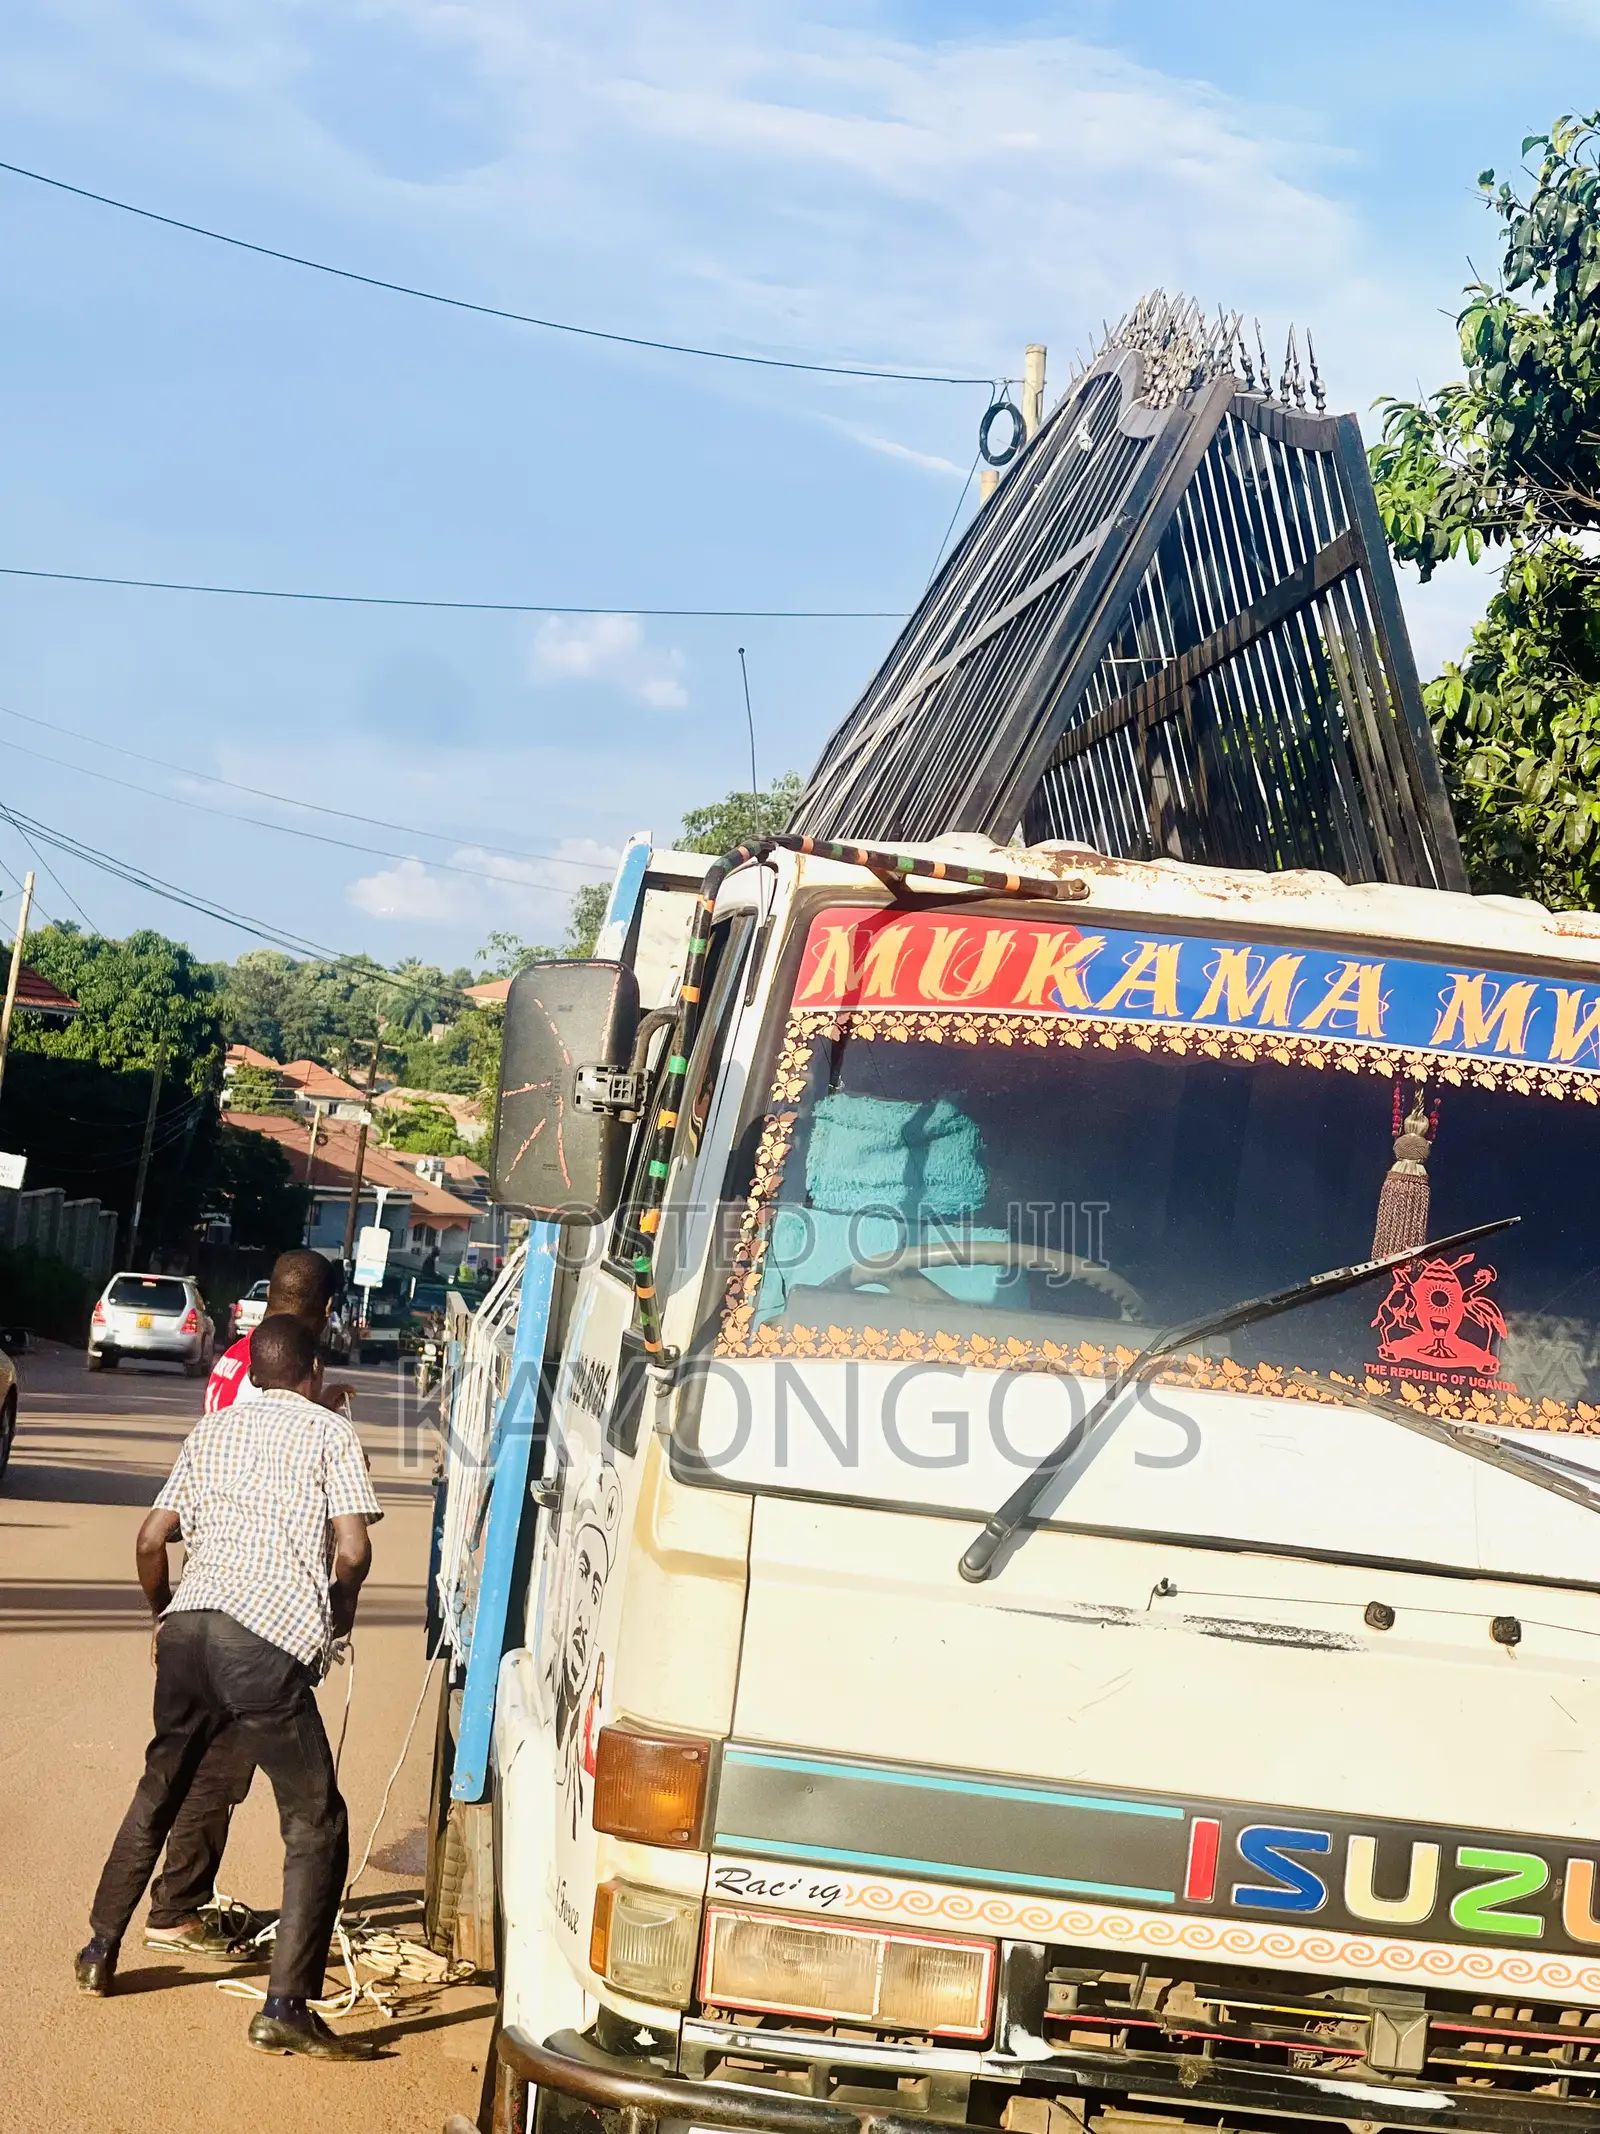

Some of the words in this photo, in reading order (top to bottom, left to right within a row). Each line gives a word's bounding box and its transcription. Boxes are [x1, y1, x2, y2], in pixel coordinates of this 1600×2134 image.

[799, 925, 1391, 1037] MUKAMA
[1363, 1362, 1387, 1376] THE
[1390, 1367, 1448, 1384] REPUBLIC
[1450, 1374, 1467, 1386] OF
[1468, 1377, 1519, 1393] UGANDA
